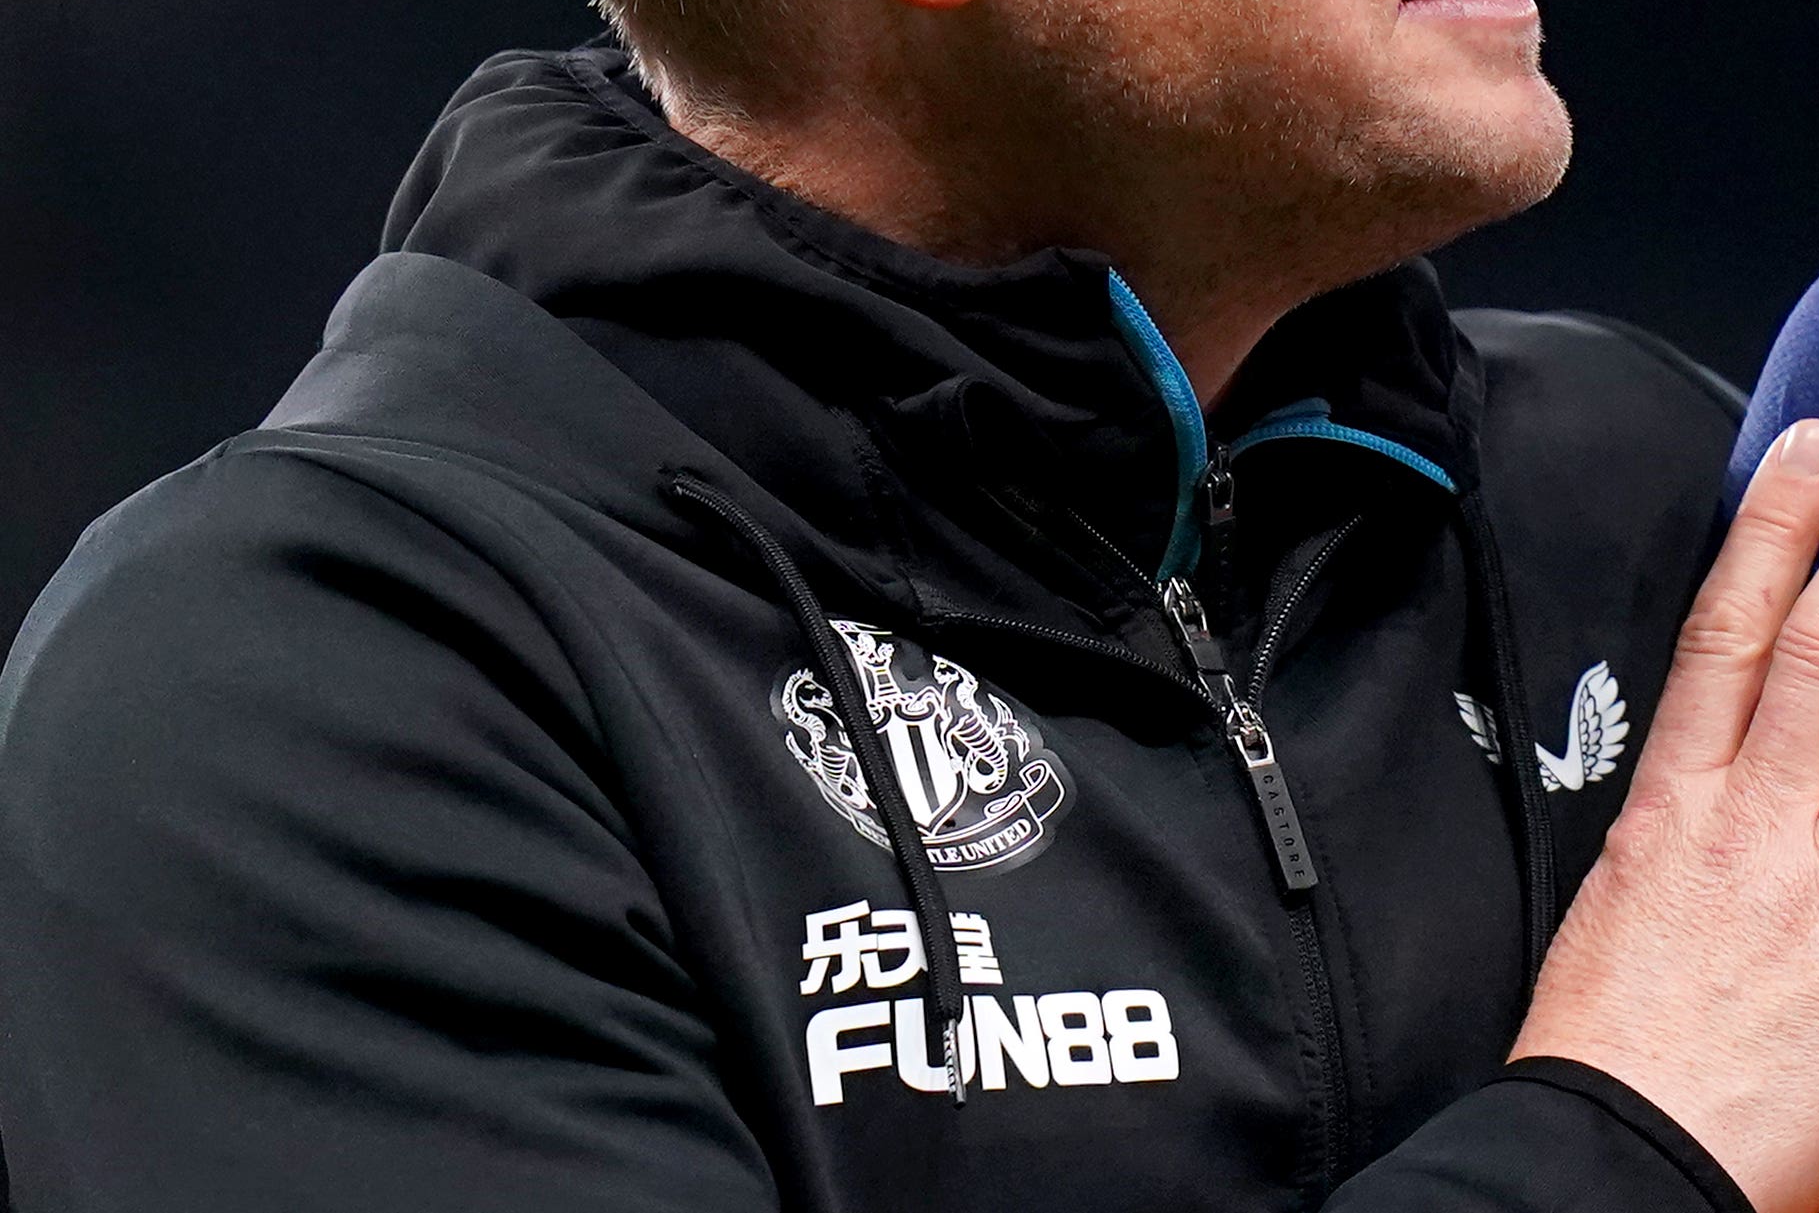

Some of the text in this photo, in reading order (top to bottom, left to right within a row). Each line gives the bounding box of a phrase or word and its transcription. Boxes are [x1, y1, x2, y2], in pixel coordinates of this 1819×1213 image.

[960, 818, 1032, 861] UNITED
[1262, 774, 1305, 878] CASTORE
[805, 989, 1180, 1107] FUN88
